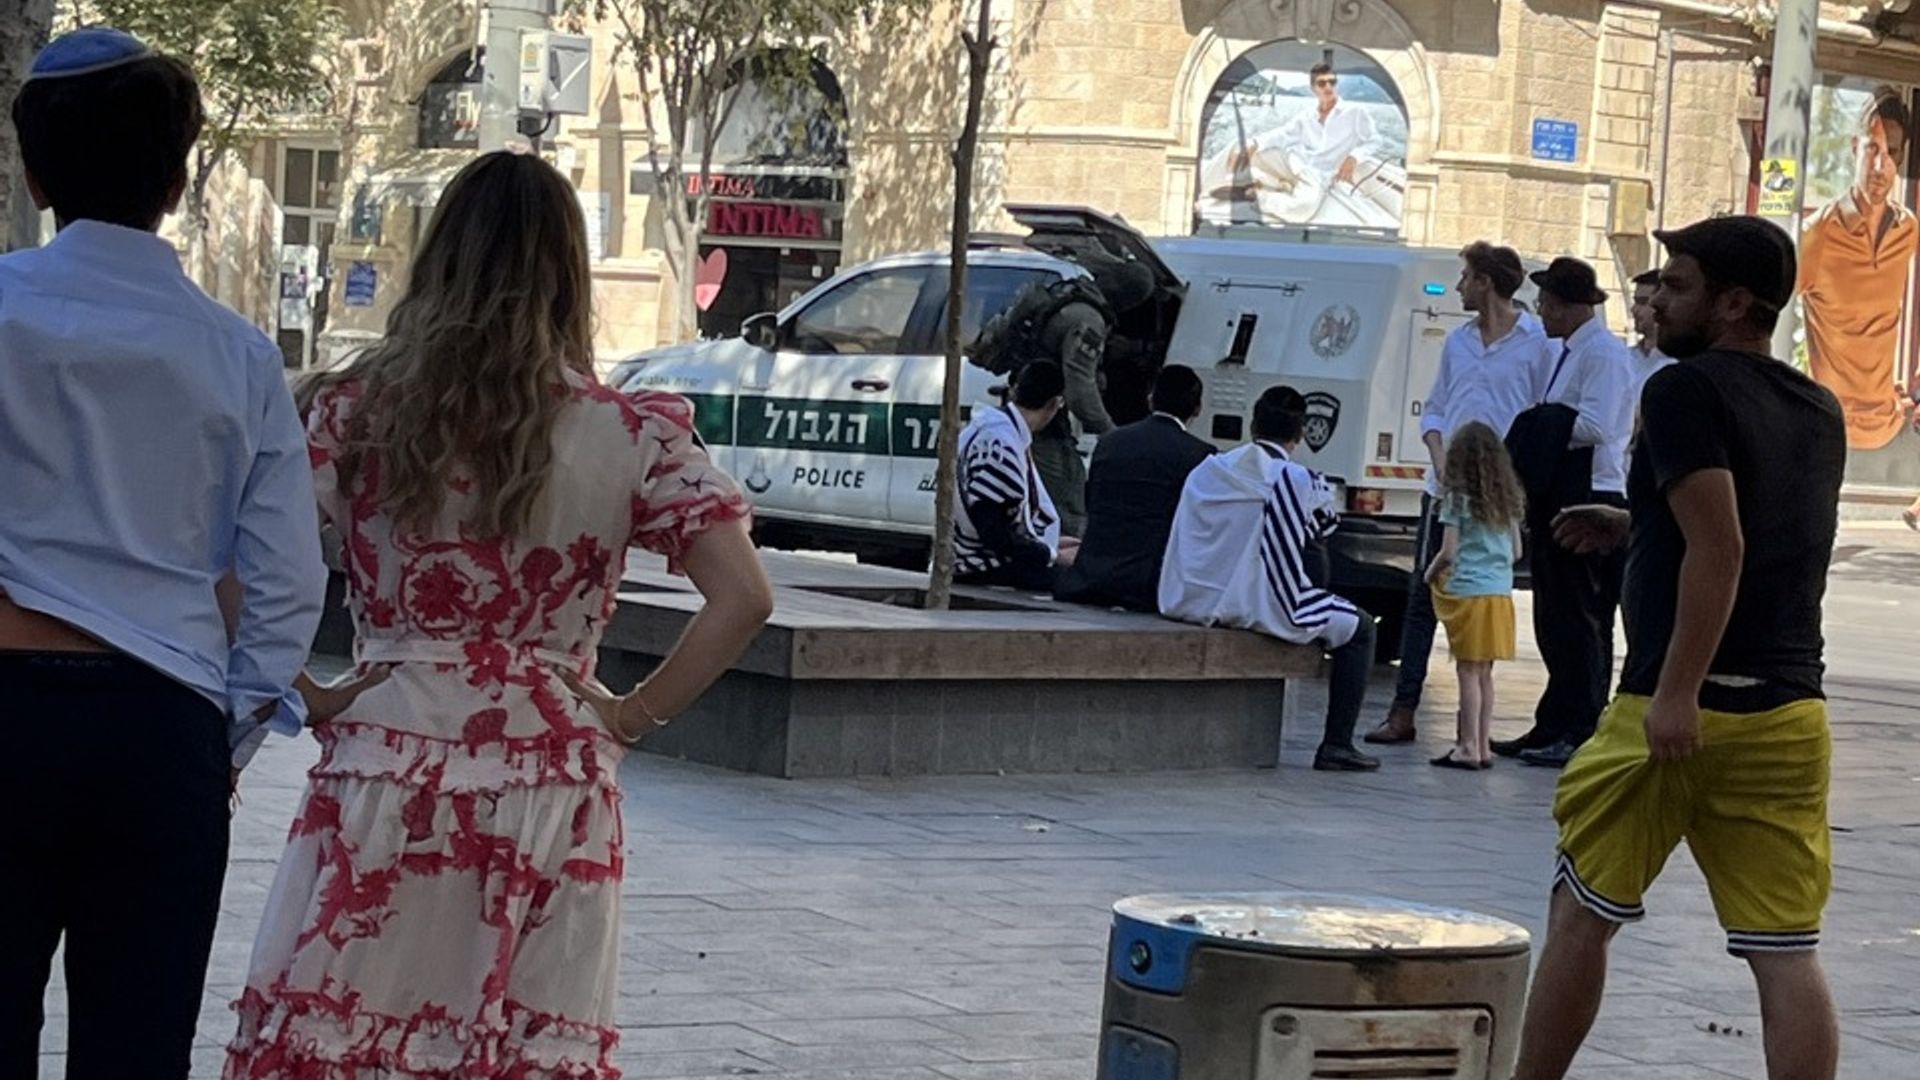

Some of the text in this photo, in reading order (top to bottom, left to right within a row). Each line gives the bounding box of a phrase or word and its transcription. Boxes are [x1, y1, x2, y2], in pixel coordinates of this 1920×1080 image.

[709, 203, 822, 237] INTIMA
[764, 402, 868, 444] הגבול
[792, 467, 865, 489] POLICE
